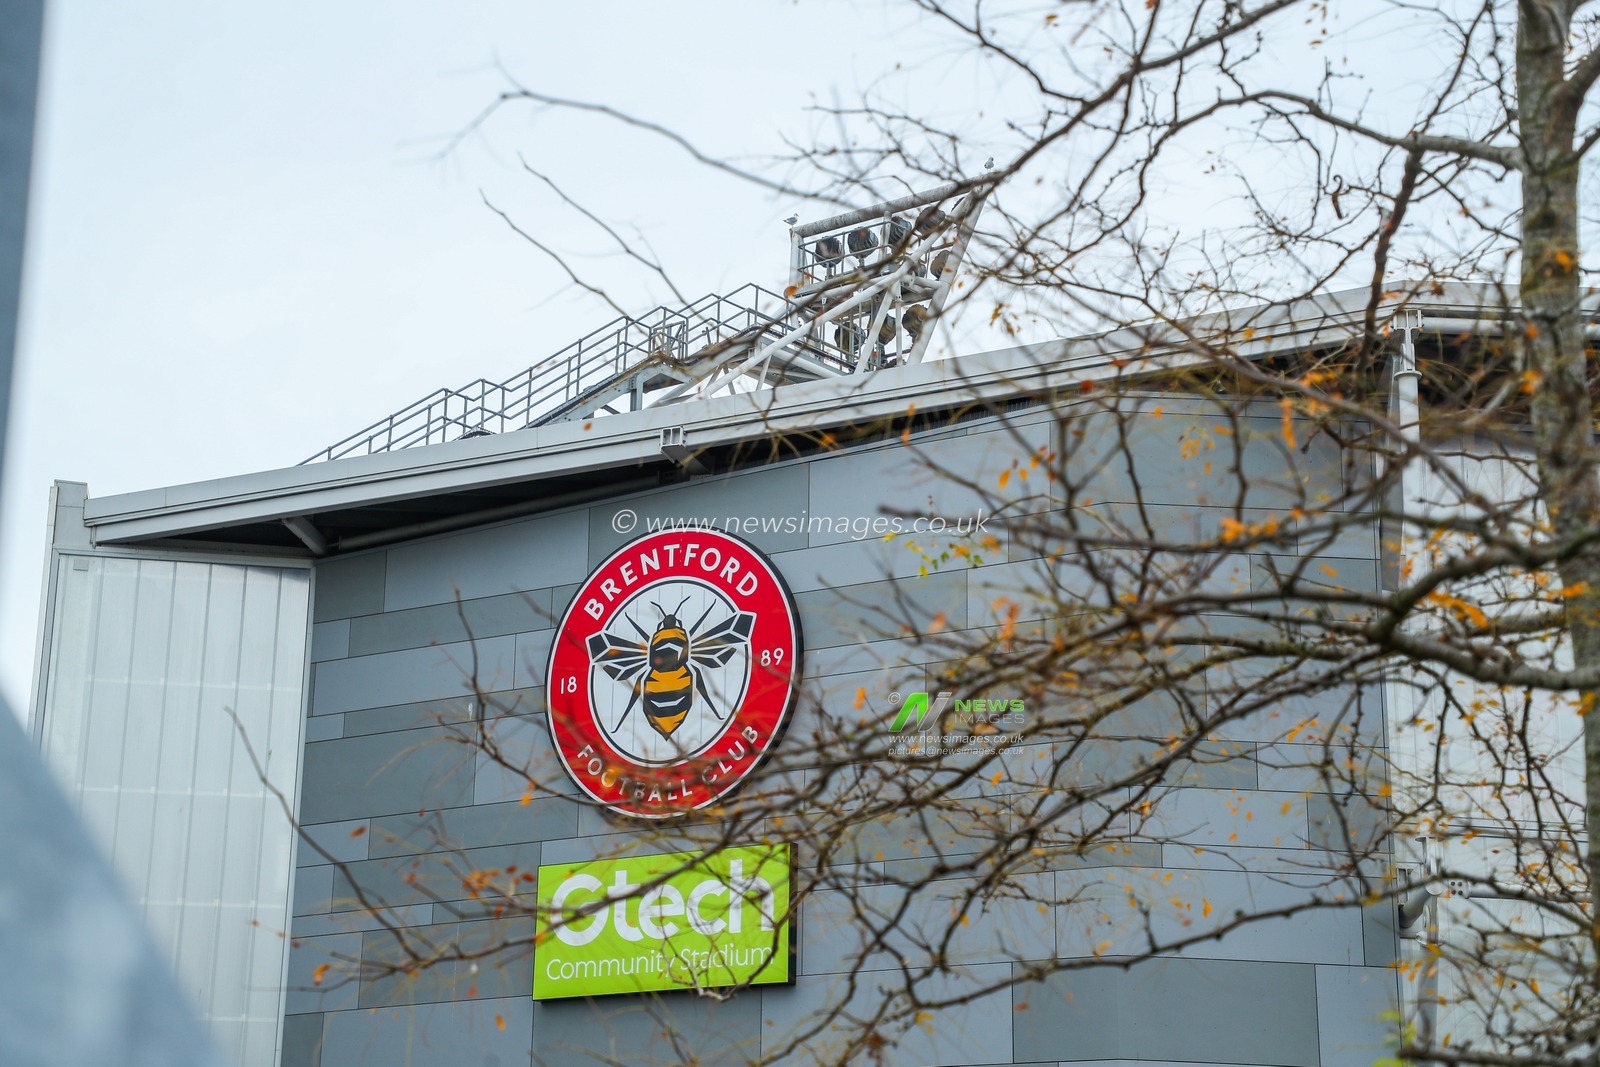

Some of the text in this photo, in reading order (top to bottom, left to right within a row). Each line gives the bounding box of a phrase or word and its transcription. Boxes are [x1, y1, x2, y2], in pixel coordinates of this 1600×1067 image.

[584, 543, 759, 621] BRENTFORD
[560, 676, 578, 695] 18
[760, 648, 785, 668] 89
[577, 725, 759, 802] FOOTBALL CLUB
[551, 858, 775, 947] Gtech
[546, 943, 774, 980] Community Stadium
